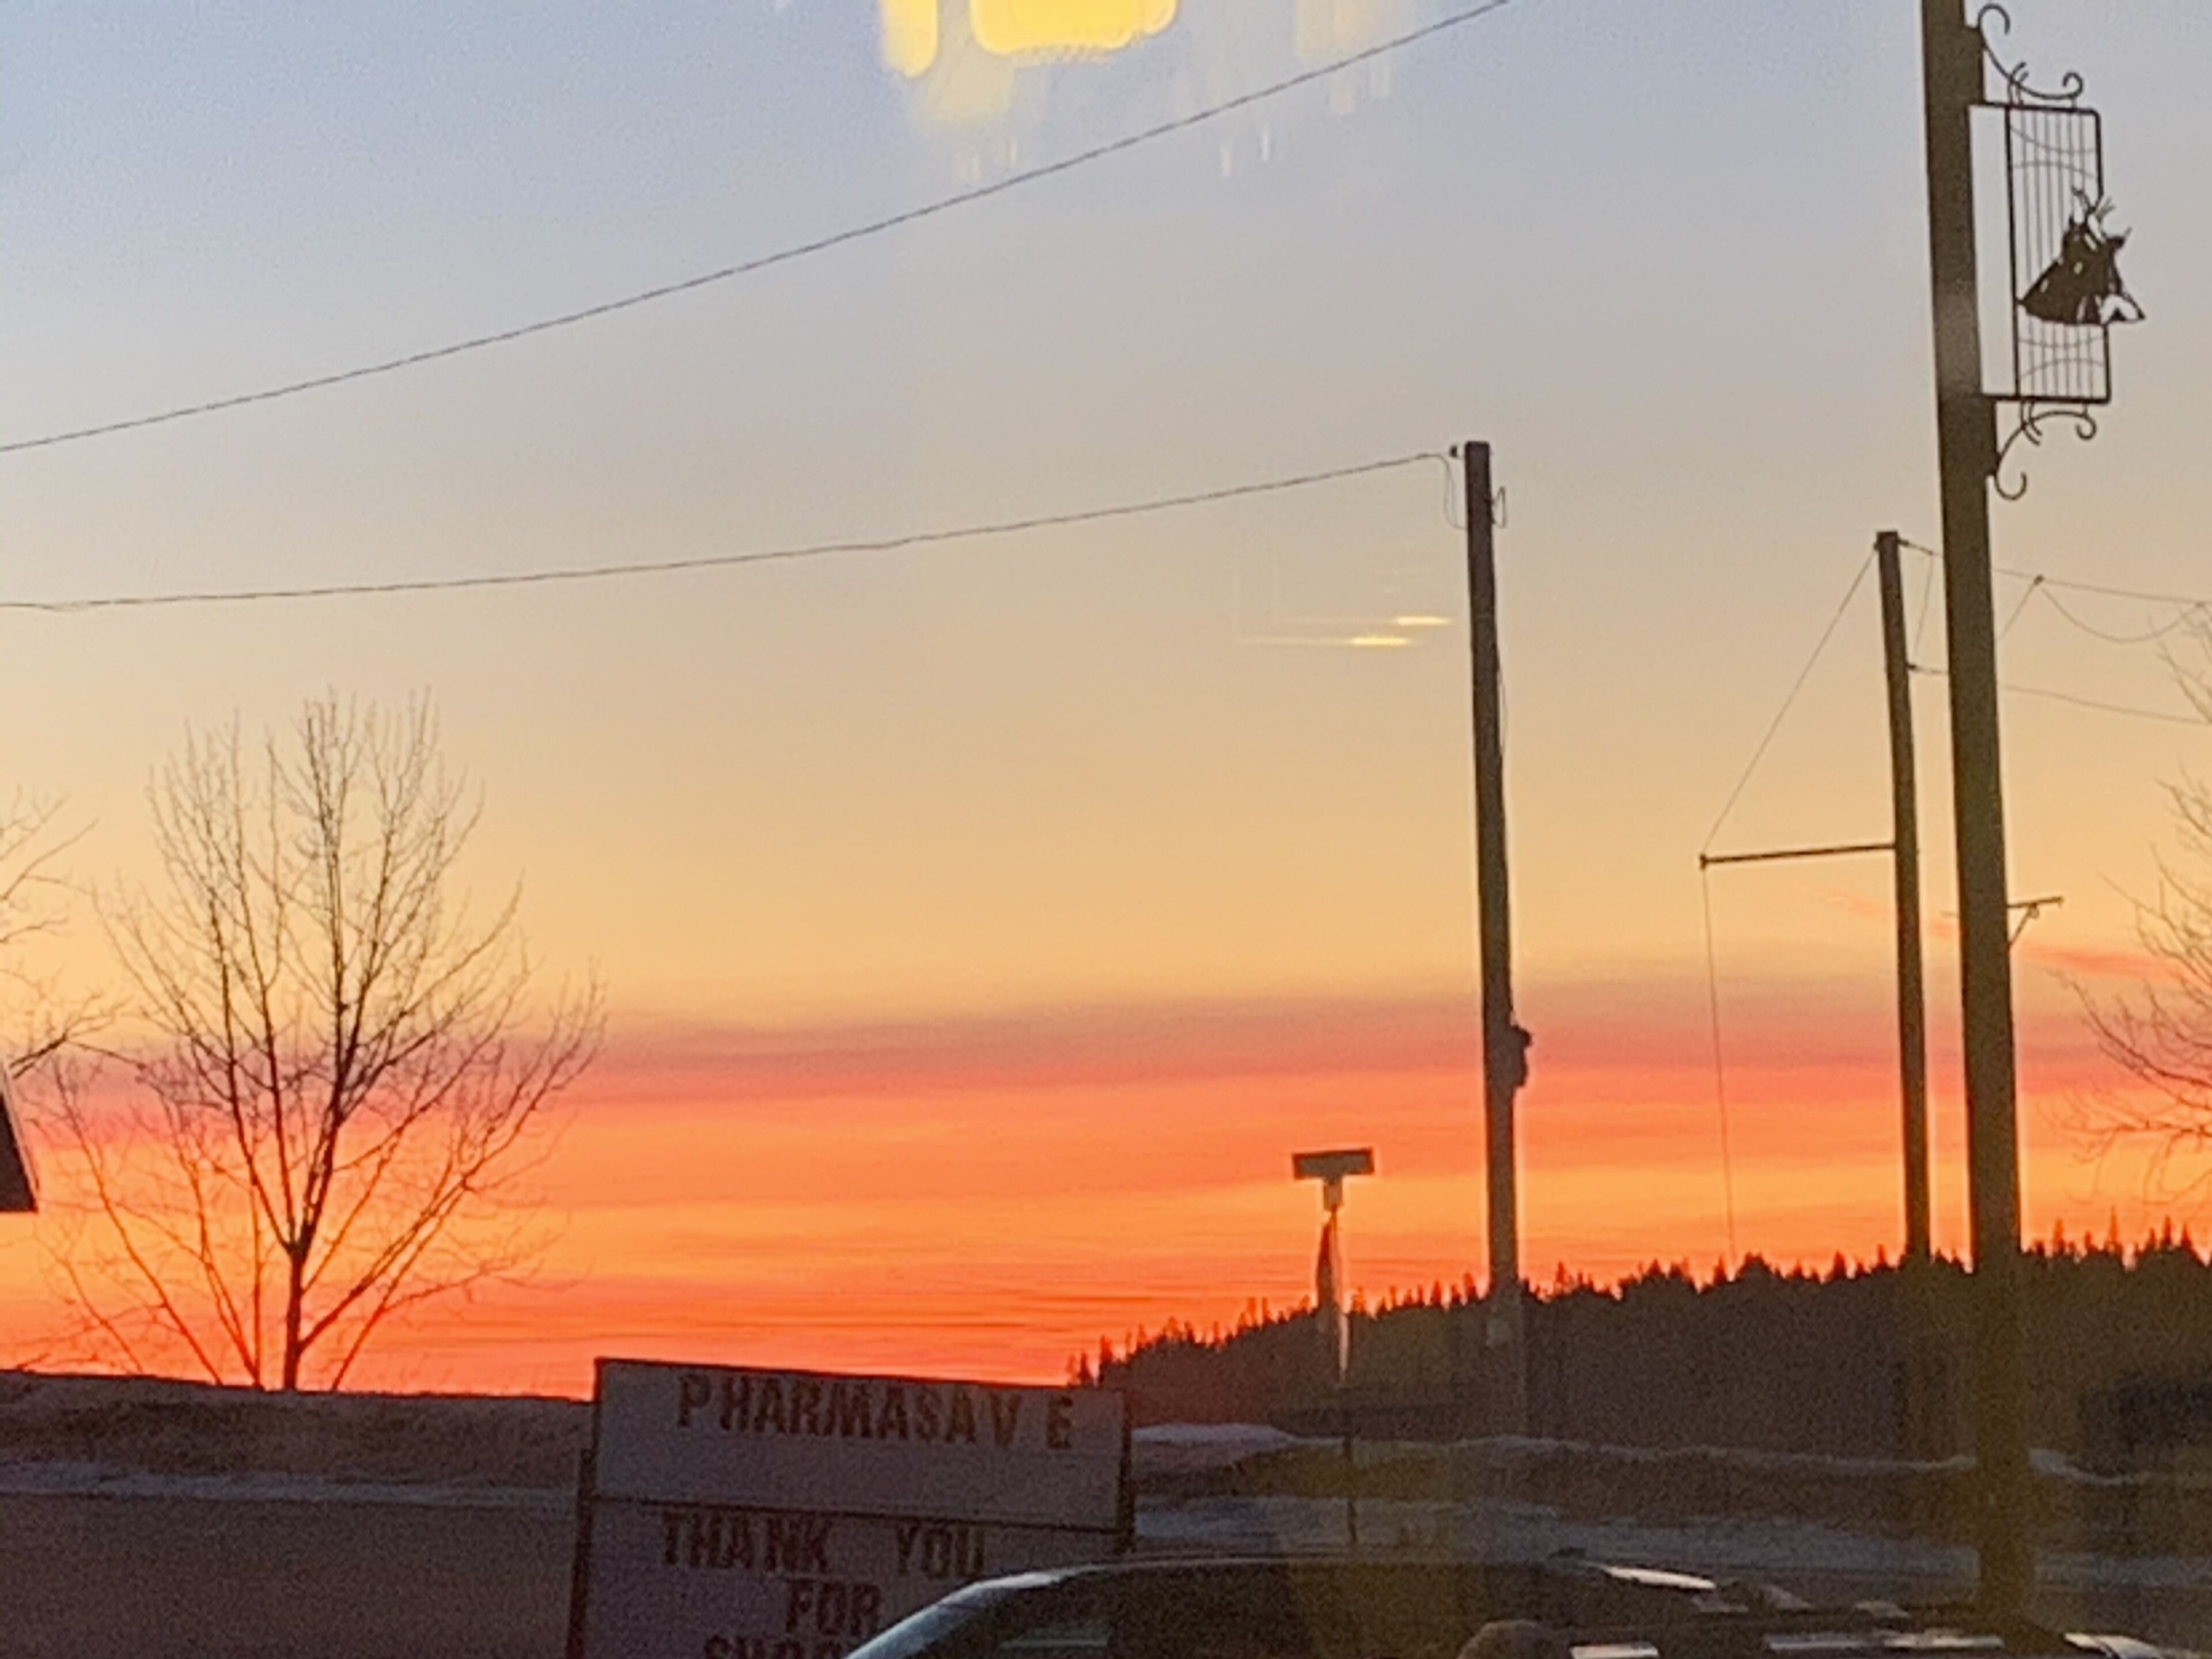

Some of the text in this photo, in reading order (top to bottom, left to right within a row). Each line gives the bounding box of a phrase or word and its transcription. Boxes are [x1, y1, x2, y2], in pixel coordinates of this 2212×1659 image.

[662, 1513, 986, 1578] THANK YOU
[786, 1578, 881, 1635] FOR
